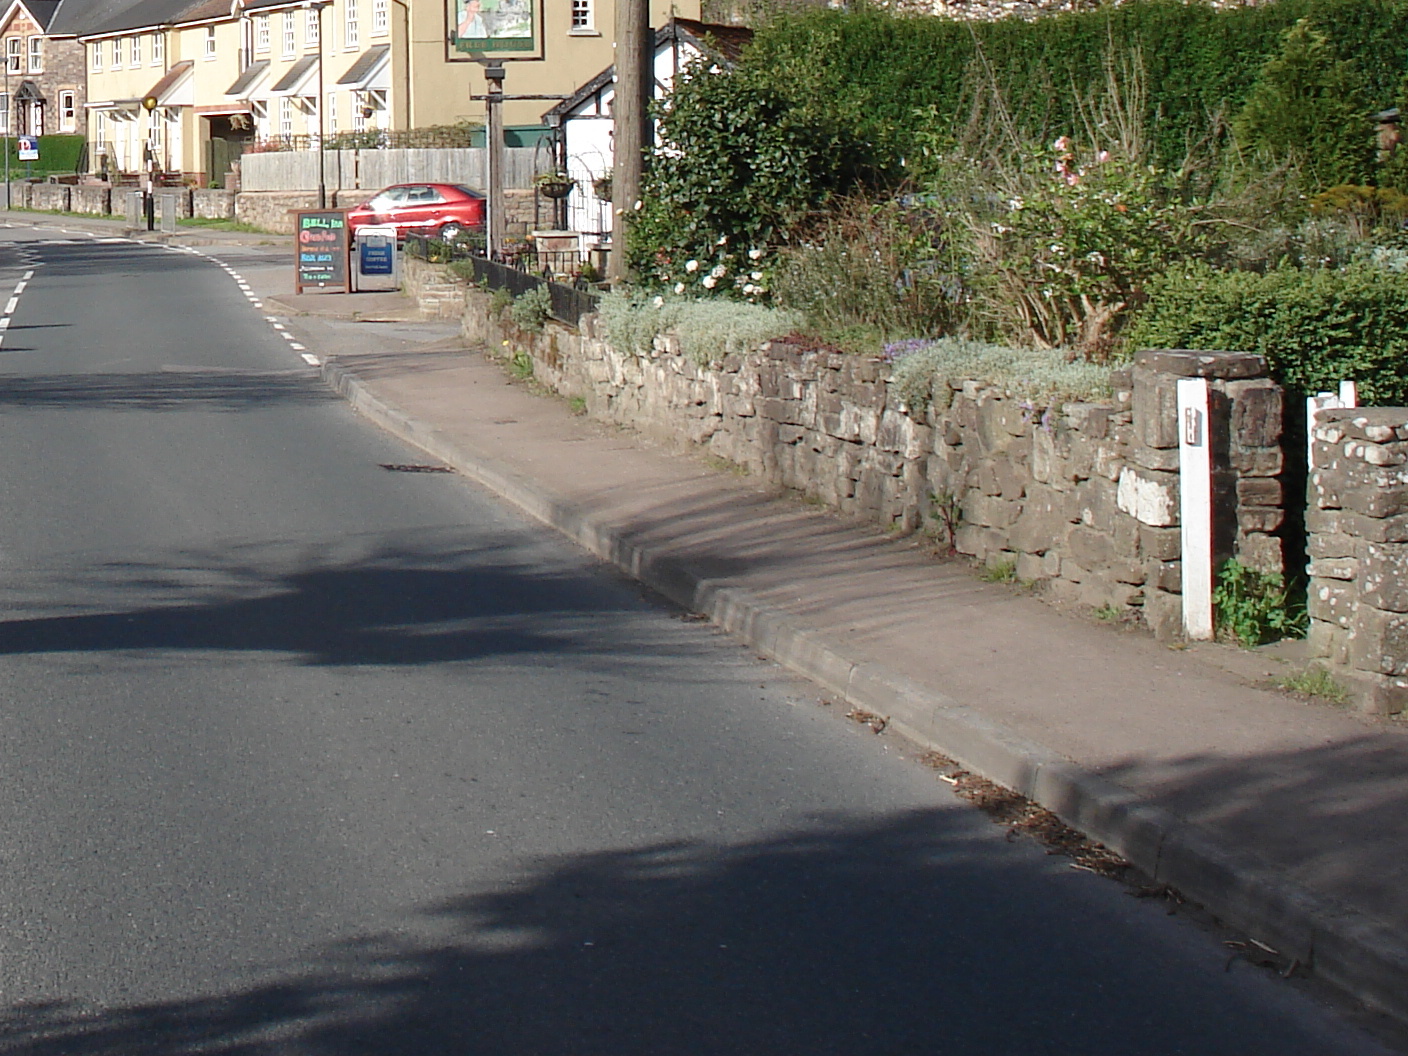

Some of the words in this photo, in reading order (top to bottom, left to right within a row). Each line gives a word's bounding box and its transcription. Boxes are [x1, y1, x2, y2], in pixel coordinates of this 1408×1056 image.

[458, 40, 488, 49] FREE
[493, 39, 532, 49] HOUSE
[302, 218, 330, 229] BELL
